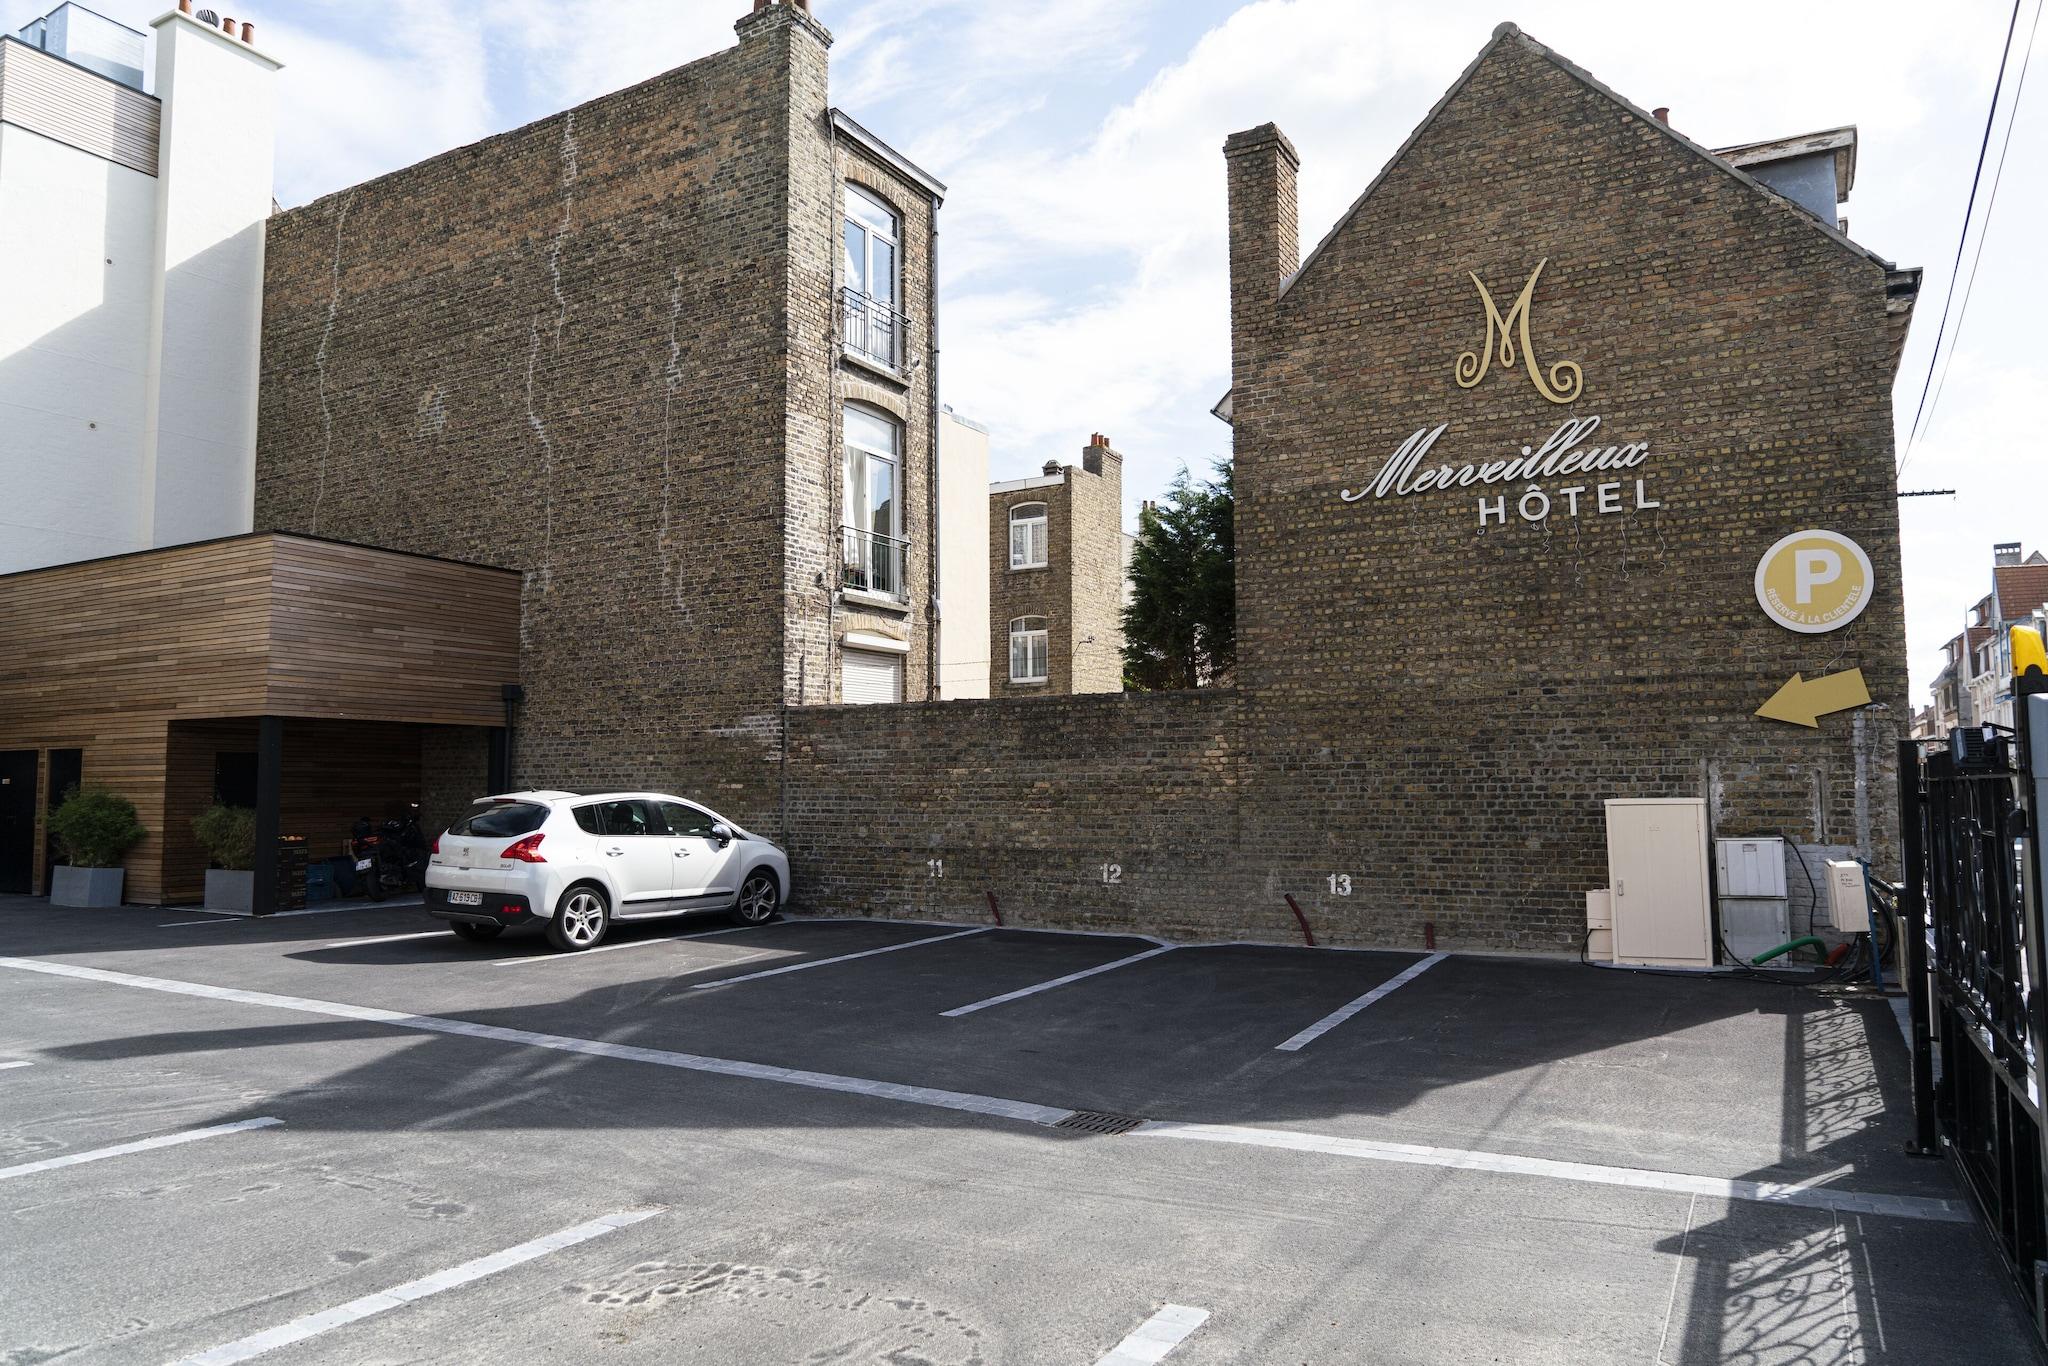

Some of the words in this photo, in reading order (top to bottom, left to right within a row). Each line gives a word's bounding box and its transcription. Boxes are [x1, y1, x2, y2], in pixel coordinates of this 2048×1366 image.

[1455, 257, 1583, 403] M
[1341, 415, 1649, 502] Merveilleux
[1478, 479, 1660, 526] HÔTEL
[1795, 549, 1841, 604] P
[1808, 614, 1820, 624] LA
[927, 858, 943, 877] 11
[1100, 863, 1121, 883] 12
[1326, 873, 1352, 896] 13
